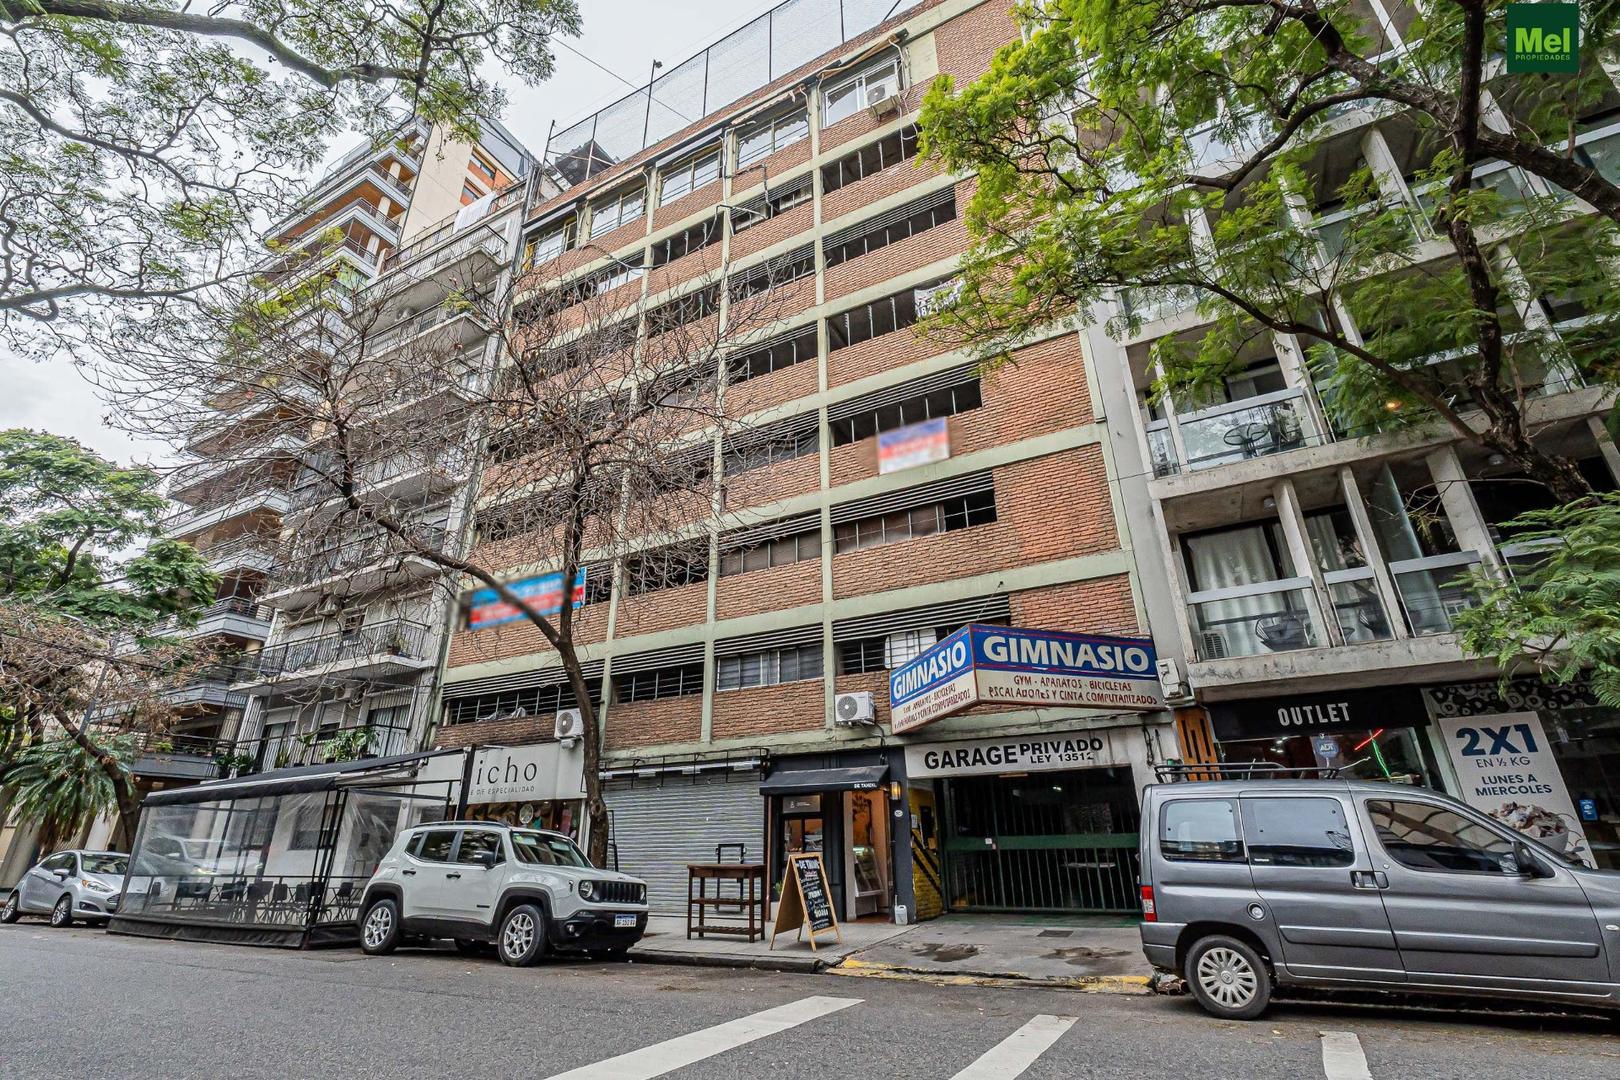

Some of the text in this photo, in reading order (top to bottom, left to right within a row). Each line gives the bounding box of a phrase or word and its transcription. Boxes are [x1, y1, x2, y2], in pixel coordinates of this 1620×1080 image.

[983, 635, 1149, 672] GIMNASIO
[893, 640, 967, 700] GIMNASIO
[1013, 675, 1132, 692] GYM APARATOS BICICLETAS
[1052, 690, 1057, 699] Y
[1059, 690, 1084, 702] CINTA
[1277, 702, 1350, 726] OUTLET
[1456, 723, 1539, 757] 2X1
[924, 737, 1103, 770] GARAGE PRIVADO
[1030, 752, 1094, 764] LEY 13512
[1476, 758, 1493, 768] EN
[1511, 756, 1531, 766] KG
[476, 756, 538, 785] icho
[1481, 773, 1538, 785] LUNES A
[487, 785, 535, 795] ESPECIALIDAD
[1475, 784, 1553, 797] MIERCOLES
